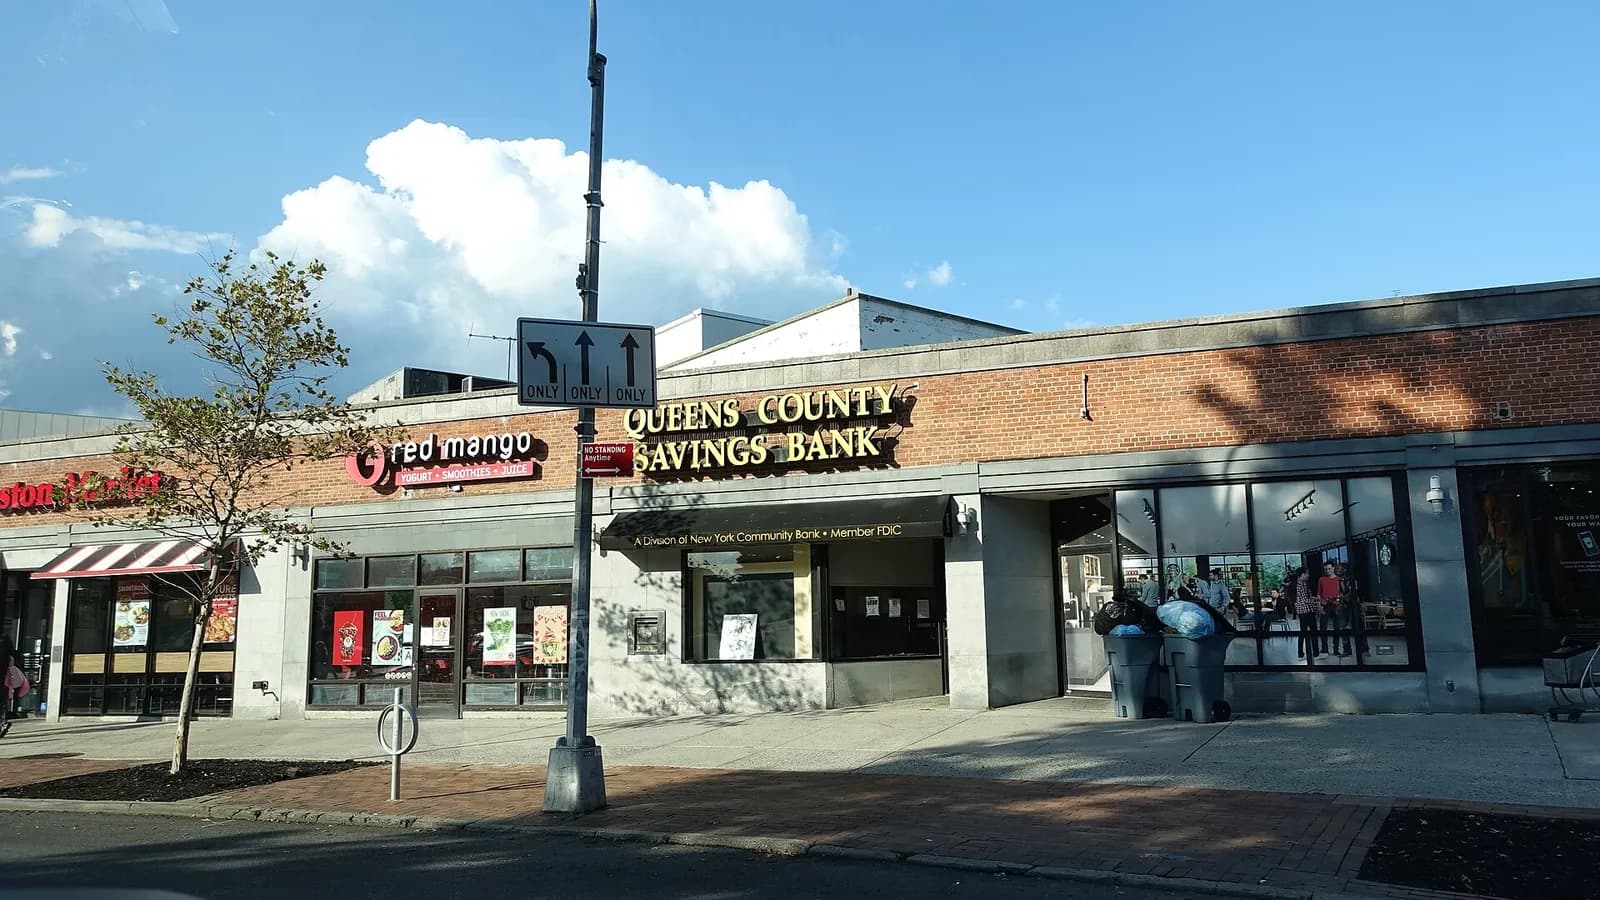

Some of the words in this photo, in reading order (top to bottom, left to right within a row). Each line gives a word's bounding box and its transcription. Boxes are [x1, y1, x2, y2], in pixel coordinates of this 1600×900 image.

[527, 384, 560, 399] ONLY
[571, 387, 603, 400] ONLY
[616, 388, 647, 401] ONLY
[623, 398, 740, 438] QUEENS
[758, 383, 898, 424] COUNTY
[391, 433, 434, 464] red
[444, 431, 531, 460] mango
[584, 446, 593, 454] NO
[594, 446, 626, 454] STANDING
[633, 434, 768, 472] SAVINGS
[787, 425, 880, 462] BANK
[584, 455, 611, 463] Anytime
[400, 471, 432, 483] YOGURT
[442, 467, 491, 480] SMOOTHIES
[501, 464, 527, 475] JUICE
[0, 481, 54, 510] ston
[633, 536, 642, 546] A
[643, 535, 676, 546] Division
[677, 534, 688, 544] of
[690, 533, 712, 544] New
[714, 532, 735, 543] York
[736, 530, 794, 543] Community
[795, 529, 821, 539] Bank
[830, 526, 876, 538] Member
[876, 524, 902, 536] FDIC
[404, 651, 412, 660] A
